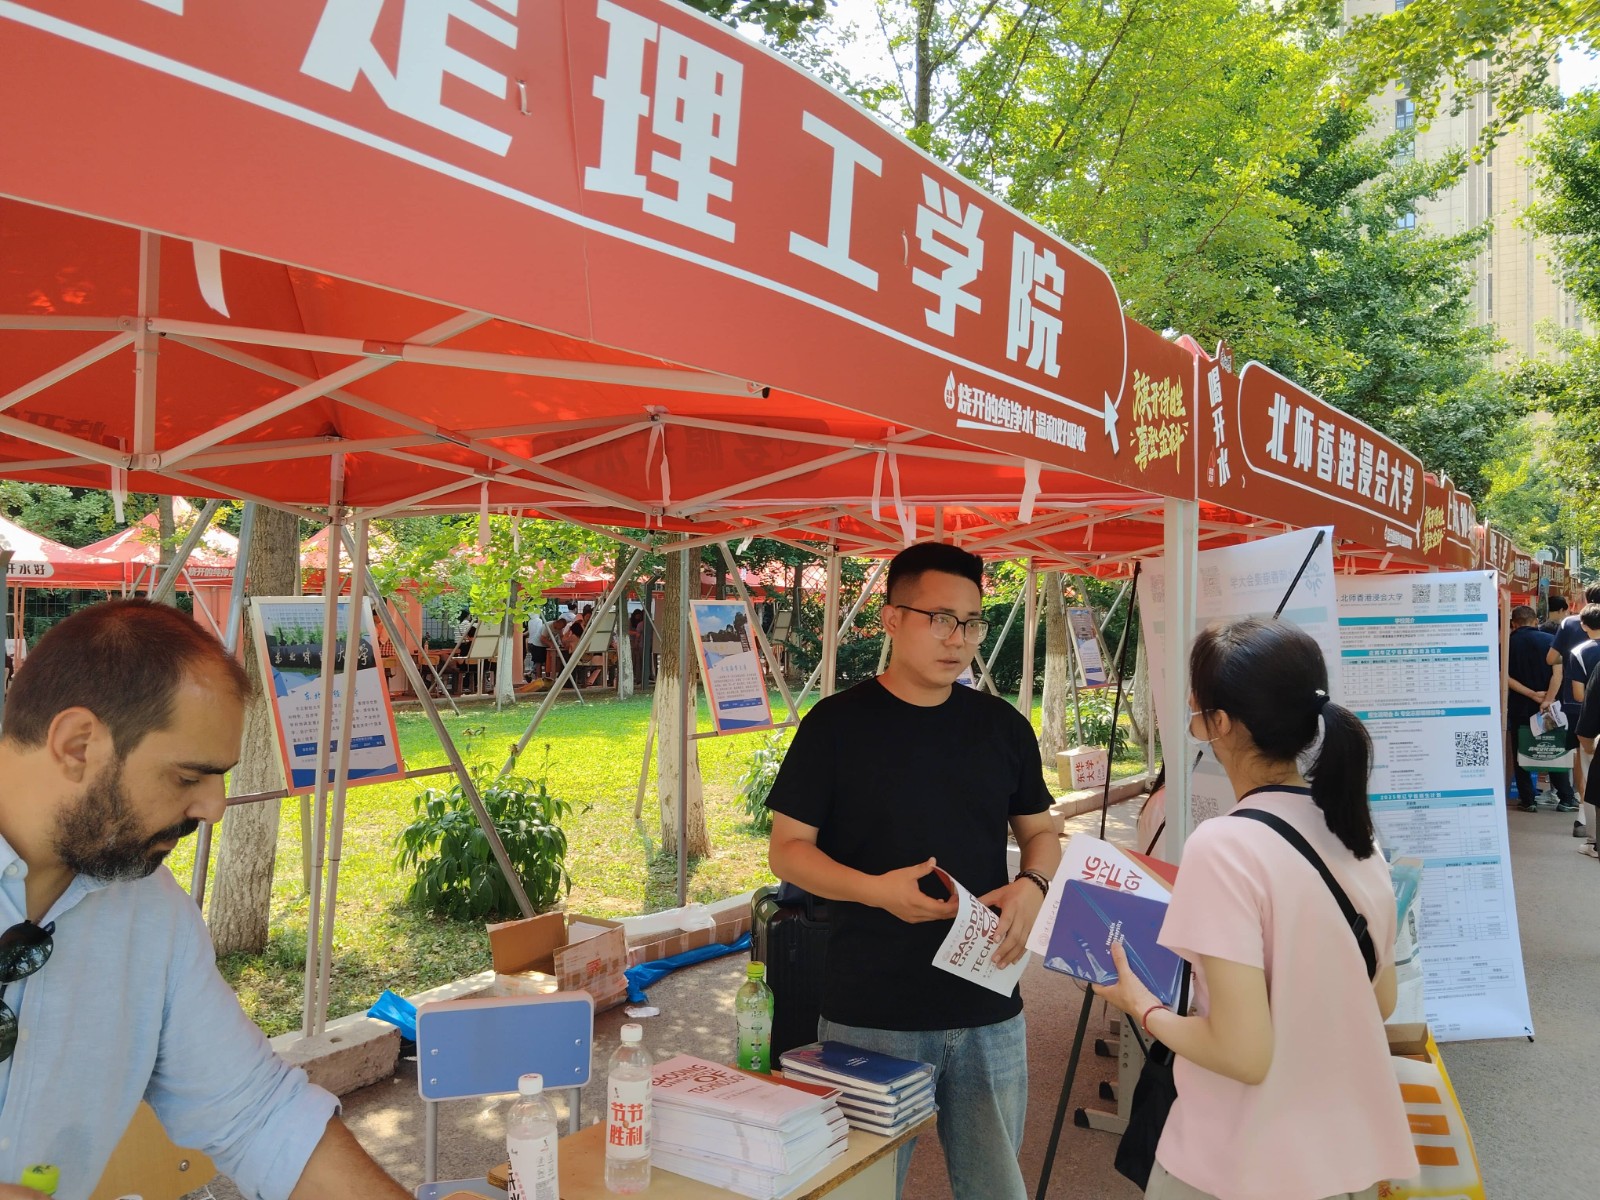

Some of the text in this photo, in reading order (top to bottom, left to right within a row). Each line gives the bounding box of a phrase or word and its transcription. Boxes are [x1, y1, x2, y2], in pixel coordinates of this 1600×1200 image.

[140, 0, 1065, 378] 定理工学院
[957, 382, 1087, 452] 烧开的纯净水 温和好吸收
[1132, 368, 1186, 423] 旗开得胜
[1207, 365, 1231, 487] 喝开水
[1266, 392, 1415, 516] 北师香港浸会大学
[1340, 593, 1404, 602] 北师香港浸会大学
[1121, 870, 1143, 895] GY
[609, 1124, 643, 1146] 胜利
[611, 1102, 644, 1123] 节节
